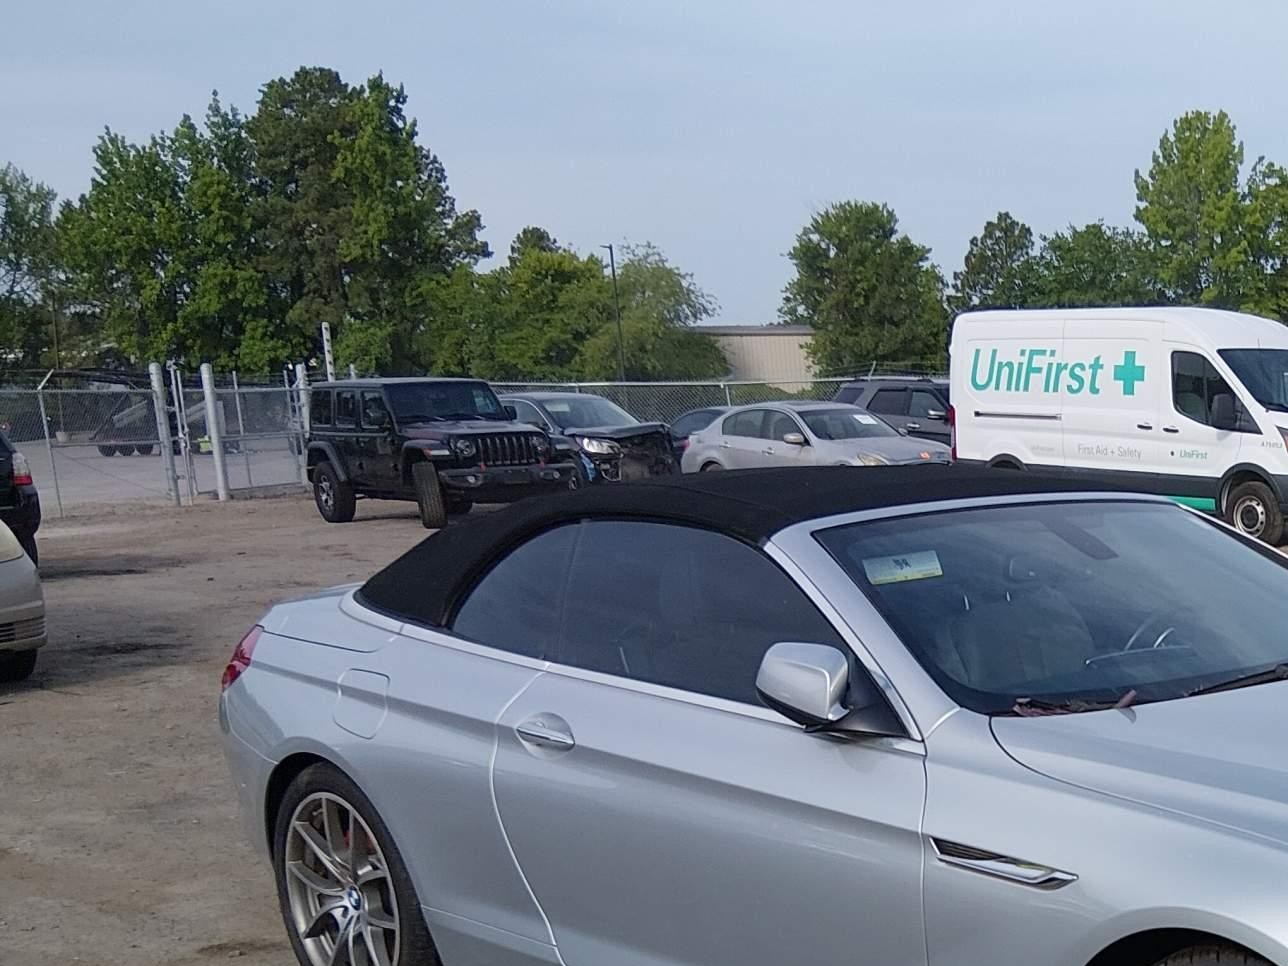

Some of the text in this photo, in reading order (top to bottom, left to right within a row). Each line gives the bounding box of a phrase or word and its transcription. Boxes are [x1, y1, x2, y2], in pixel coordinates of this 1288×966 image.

[970, 348, 1104, 395] UniFirst
[1078, 443, 1095, 456] First
[1096, 444, 1108, 456] Aid
[1118, 446, 1142, 461] Safety
[1179, 449, 1208, 460] UniFirst
